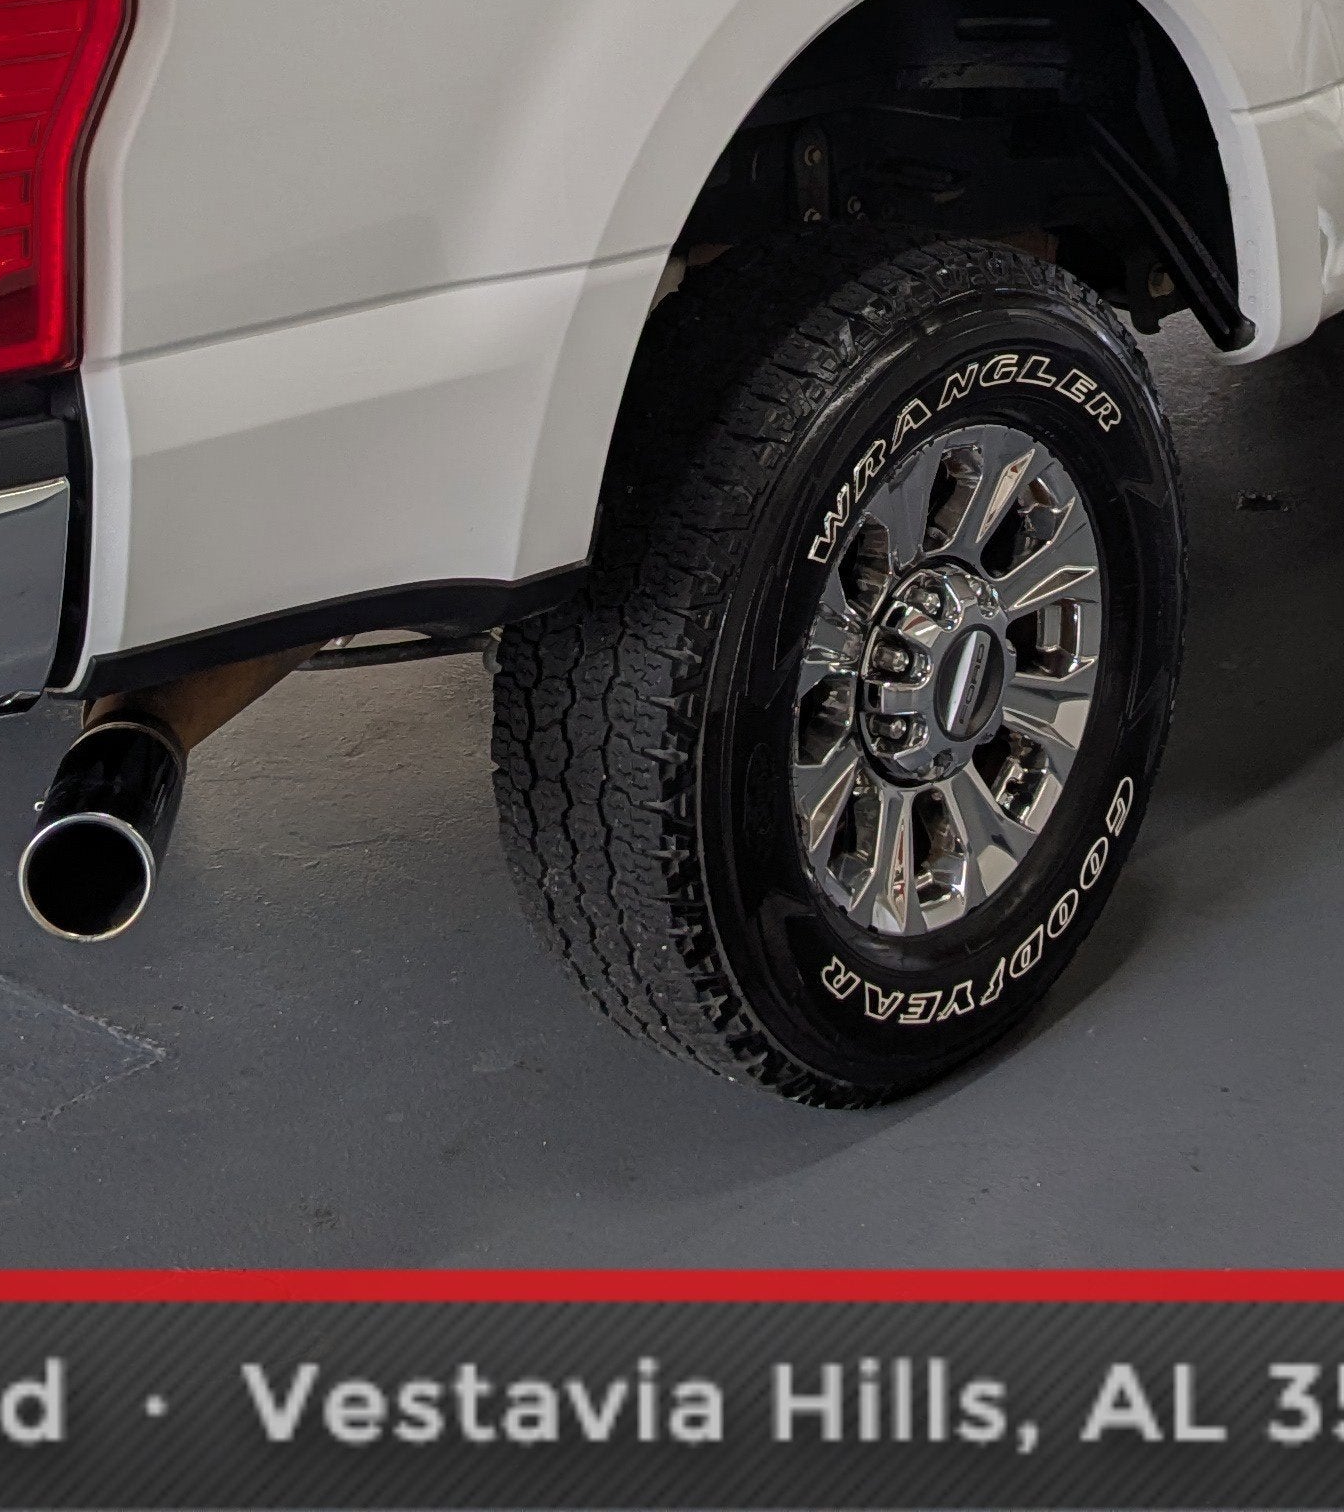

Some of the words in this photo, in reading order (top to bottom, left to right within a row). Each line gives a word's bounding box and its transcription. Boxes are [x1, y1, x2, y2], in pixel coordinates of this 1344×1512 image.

[808, 354, 1122, 563] WRANGLER
[959, 643, 985, 724] FORD
[822, 775, 1135, 1024] GOODYEAR
